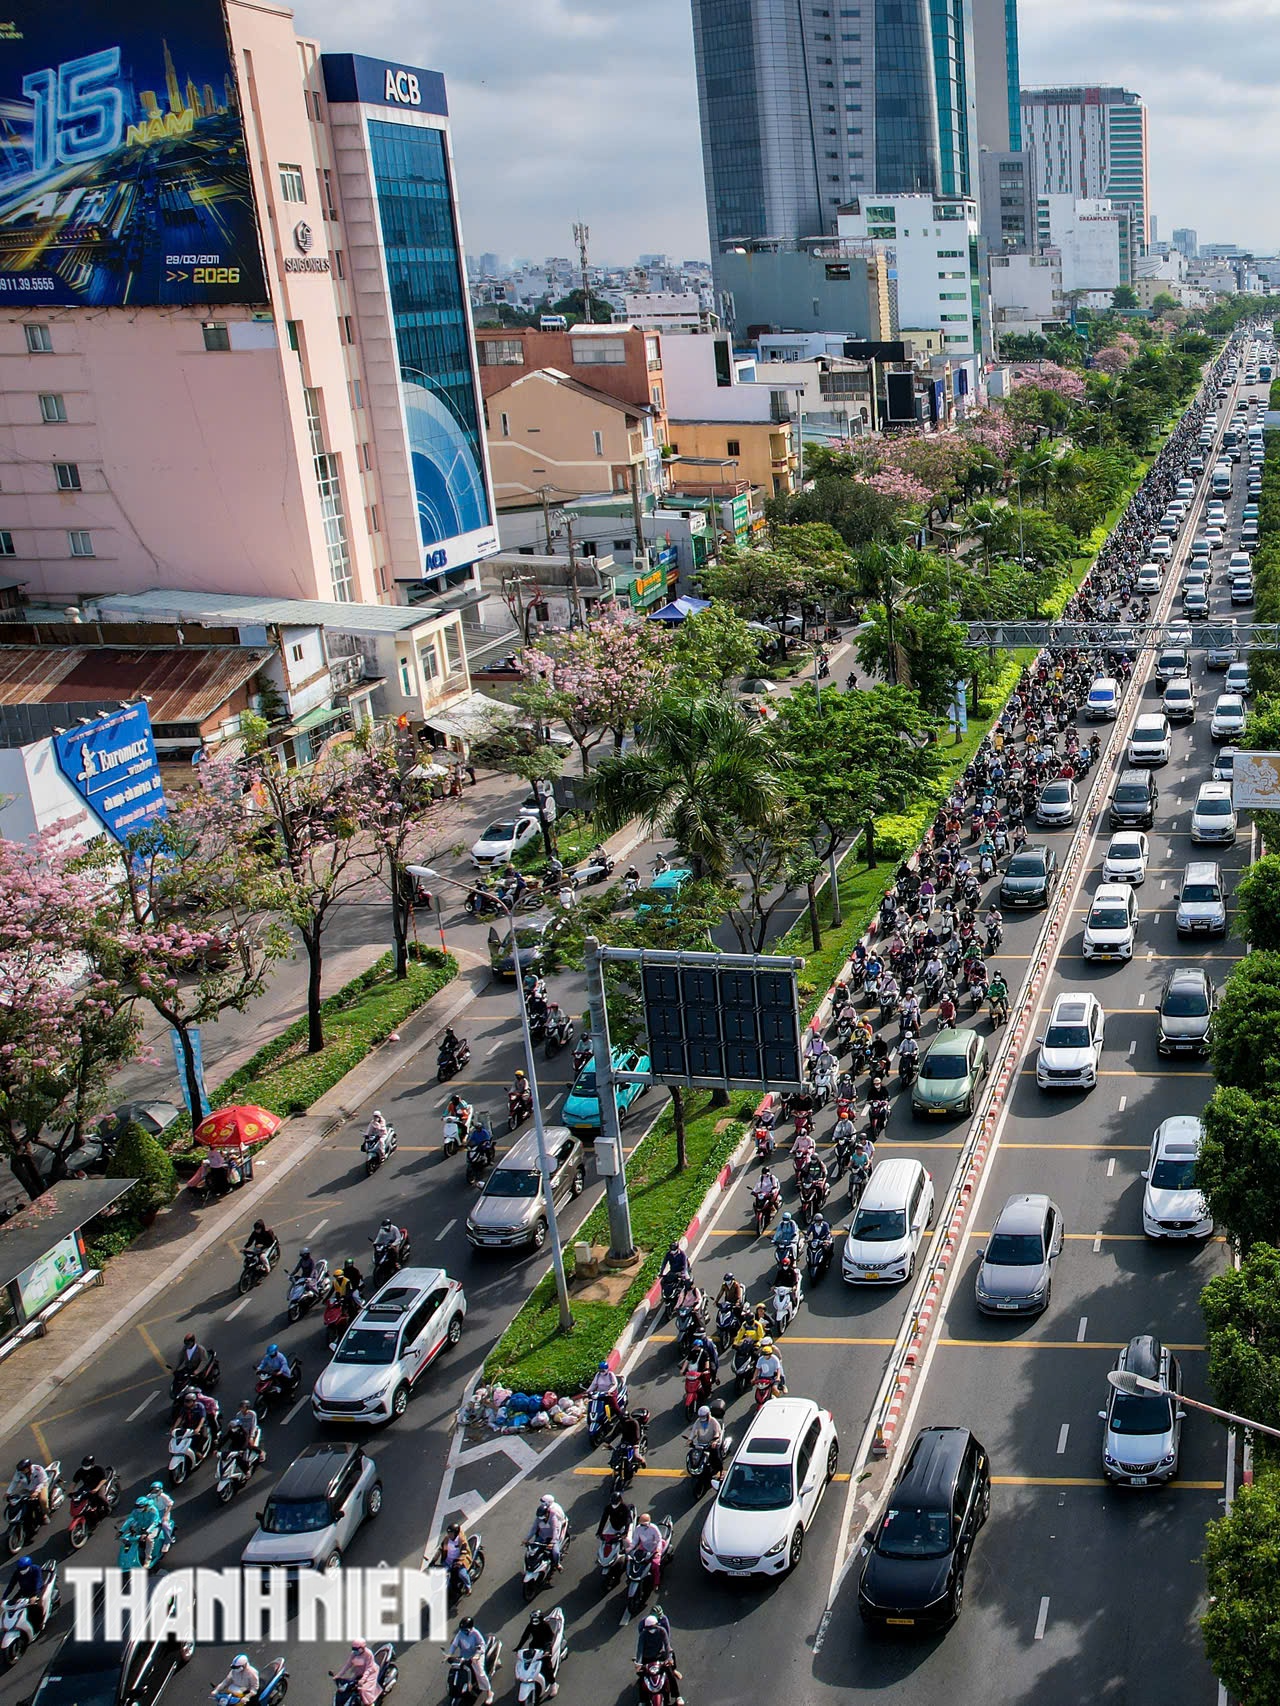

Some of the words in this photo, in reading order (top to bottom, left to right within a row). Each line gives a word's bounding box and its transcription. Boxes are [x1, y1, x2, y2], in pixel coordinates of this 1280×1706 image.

[384, 68, 422, 106] ACB
[22, 46, 122, 172] 15
[126, 107, 194, 148] NĂM
[165, 254, 220, 265] 29/03/2011
[284, 256, 331, 273] SAIGONRES
[192, 266, 241, 284] 2026
[425, 548, 448, 574] ACB
